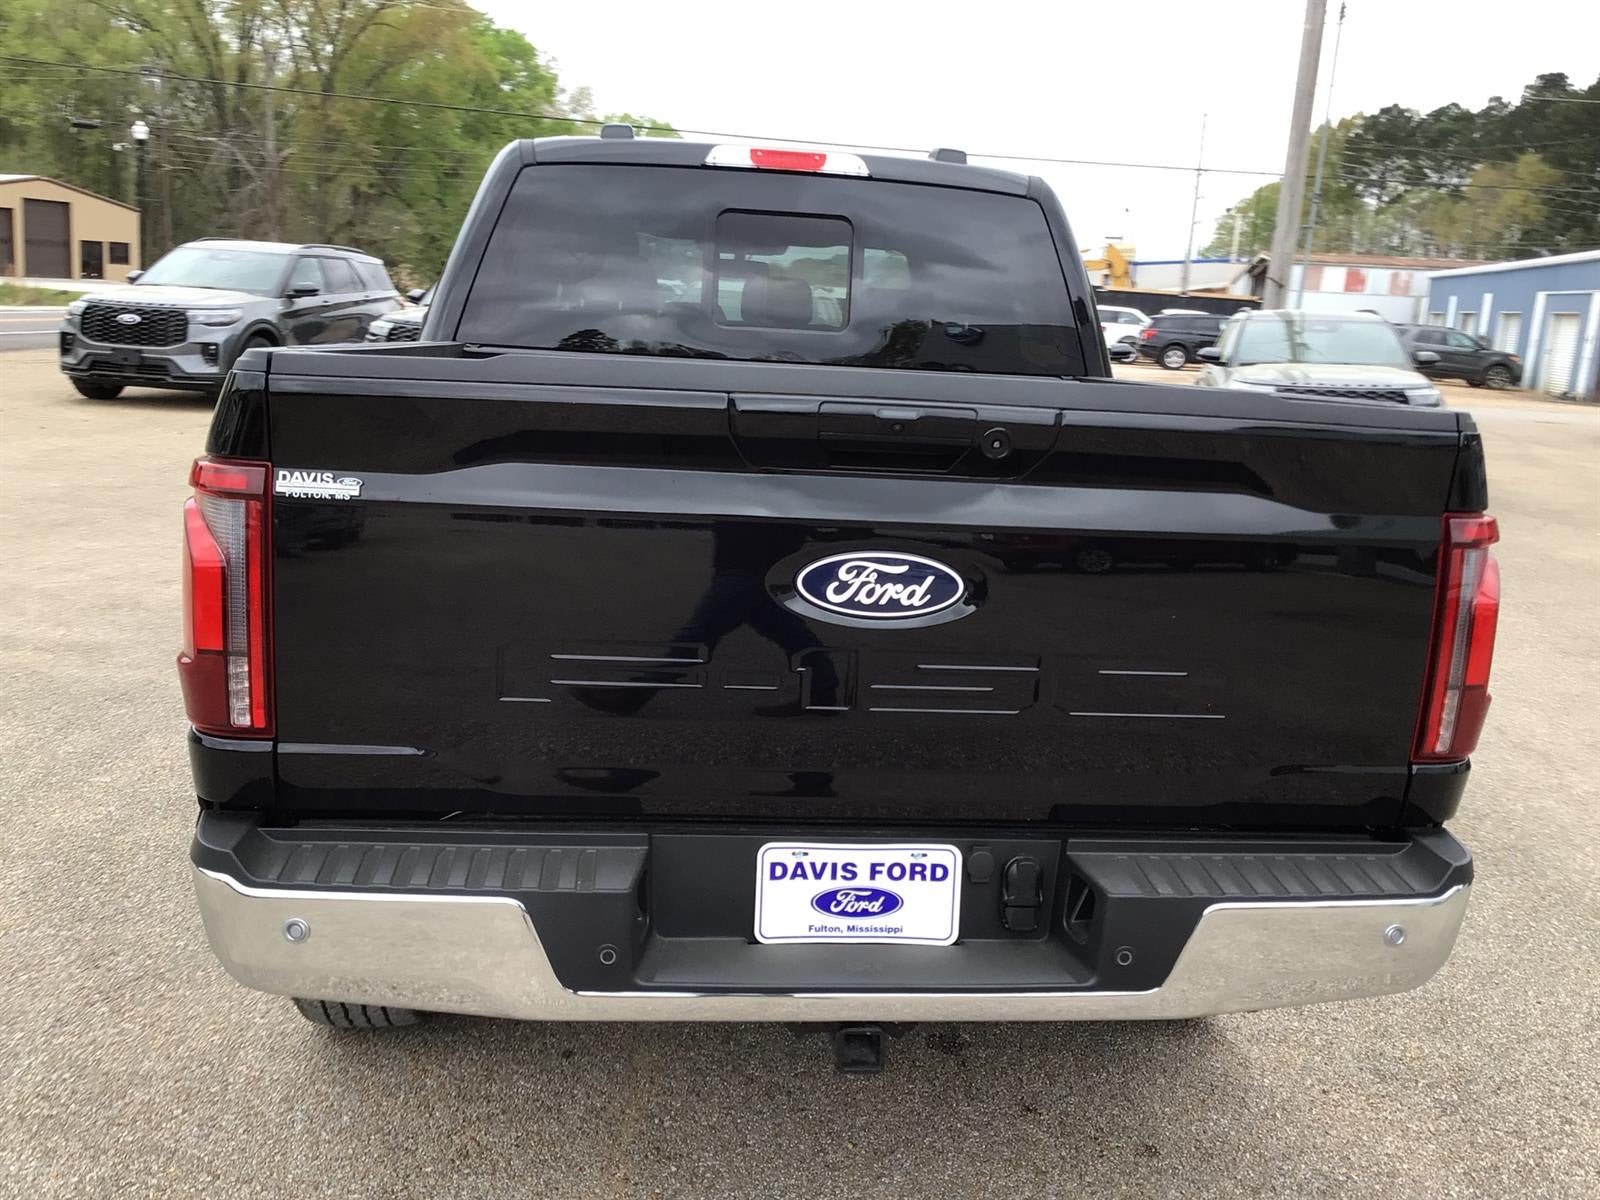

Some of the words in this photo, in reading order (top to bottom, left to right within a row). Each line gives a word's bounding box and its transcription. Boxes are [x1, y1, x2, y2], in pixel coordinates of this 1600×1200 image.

[278, 470, 334, 484] DAVIS
[335, 491, 351, 500] MS
[826, 560, 935, 607] Ford
[769, 861, 858, 881] DAVIS
[869, 862, 949, 882] FORD
[830, 890, 885, 913] Ford
[808, 925, 843, 934] Fulton,
[847, 925, 903, 934] Mississippi
